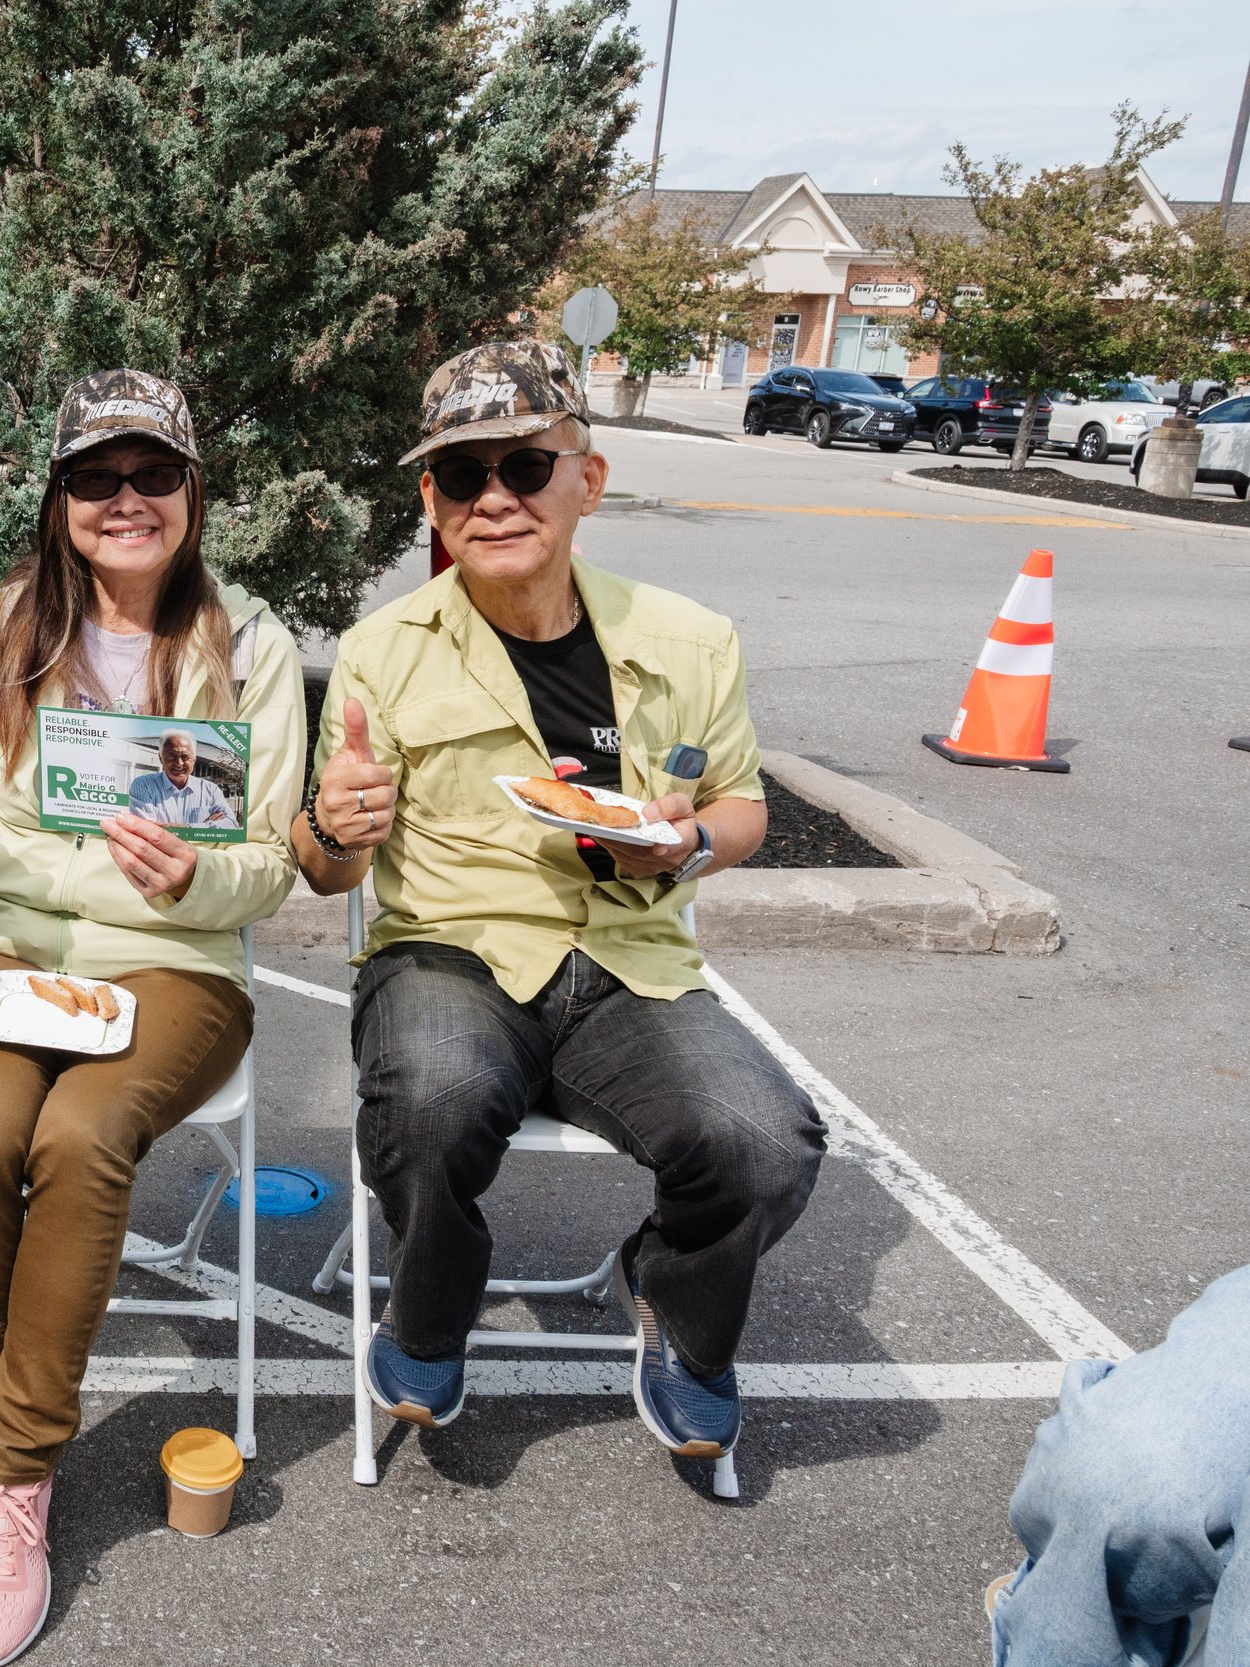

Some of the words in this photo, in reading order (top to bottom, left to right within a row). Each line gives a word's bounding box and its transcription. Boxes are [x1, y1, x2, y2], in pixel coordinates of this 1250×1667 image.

[854, 285, 871, 294] Rowy
[895, 286, 911, 295] Shop
[440, 383, 518, 414] ECHO
[94, 399, 167, 423] ECHO
[45, 715, 91, 728] RELIABLE.
[45, 724, 111, 739] RESPONSIBLE.
[217, 724, 247, 752] RE-ELECT
[45, 734, 106, 748] RESPONSIVE.
[79, 773, 100, 781] VOTE
[100, 775, 116, 783] FOR
[79, 781, 106, 792] Mario
[108, 785, 118, 793] G.
